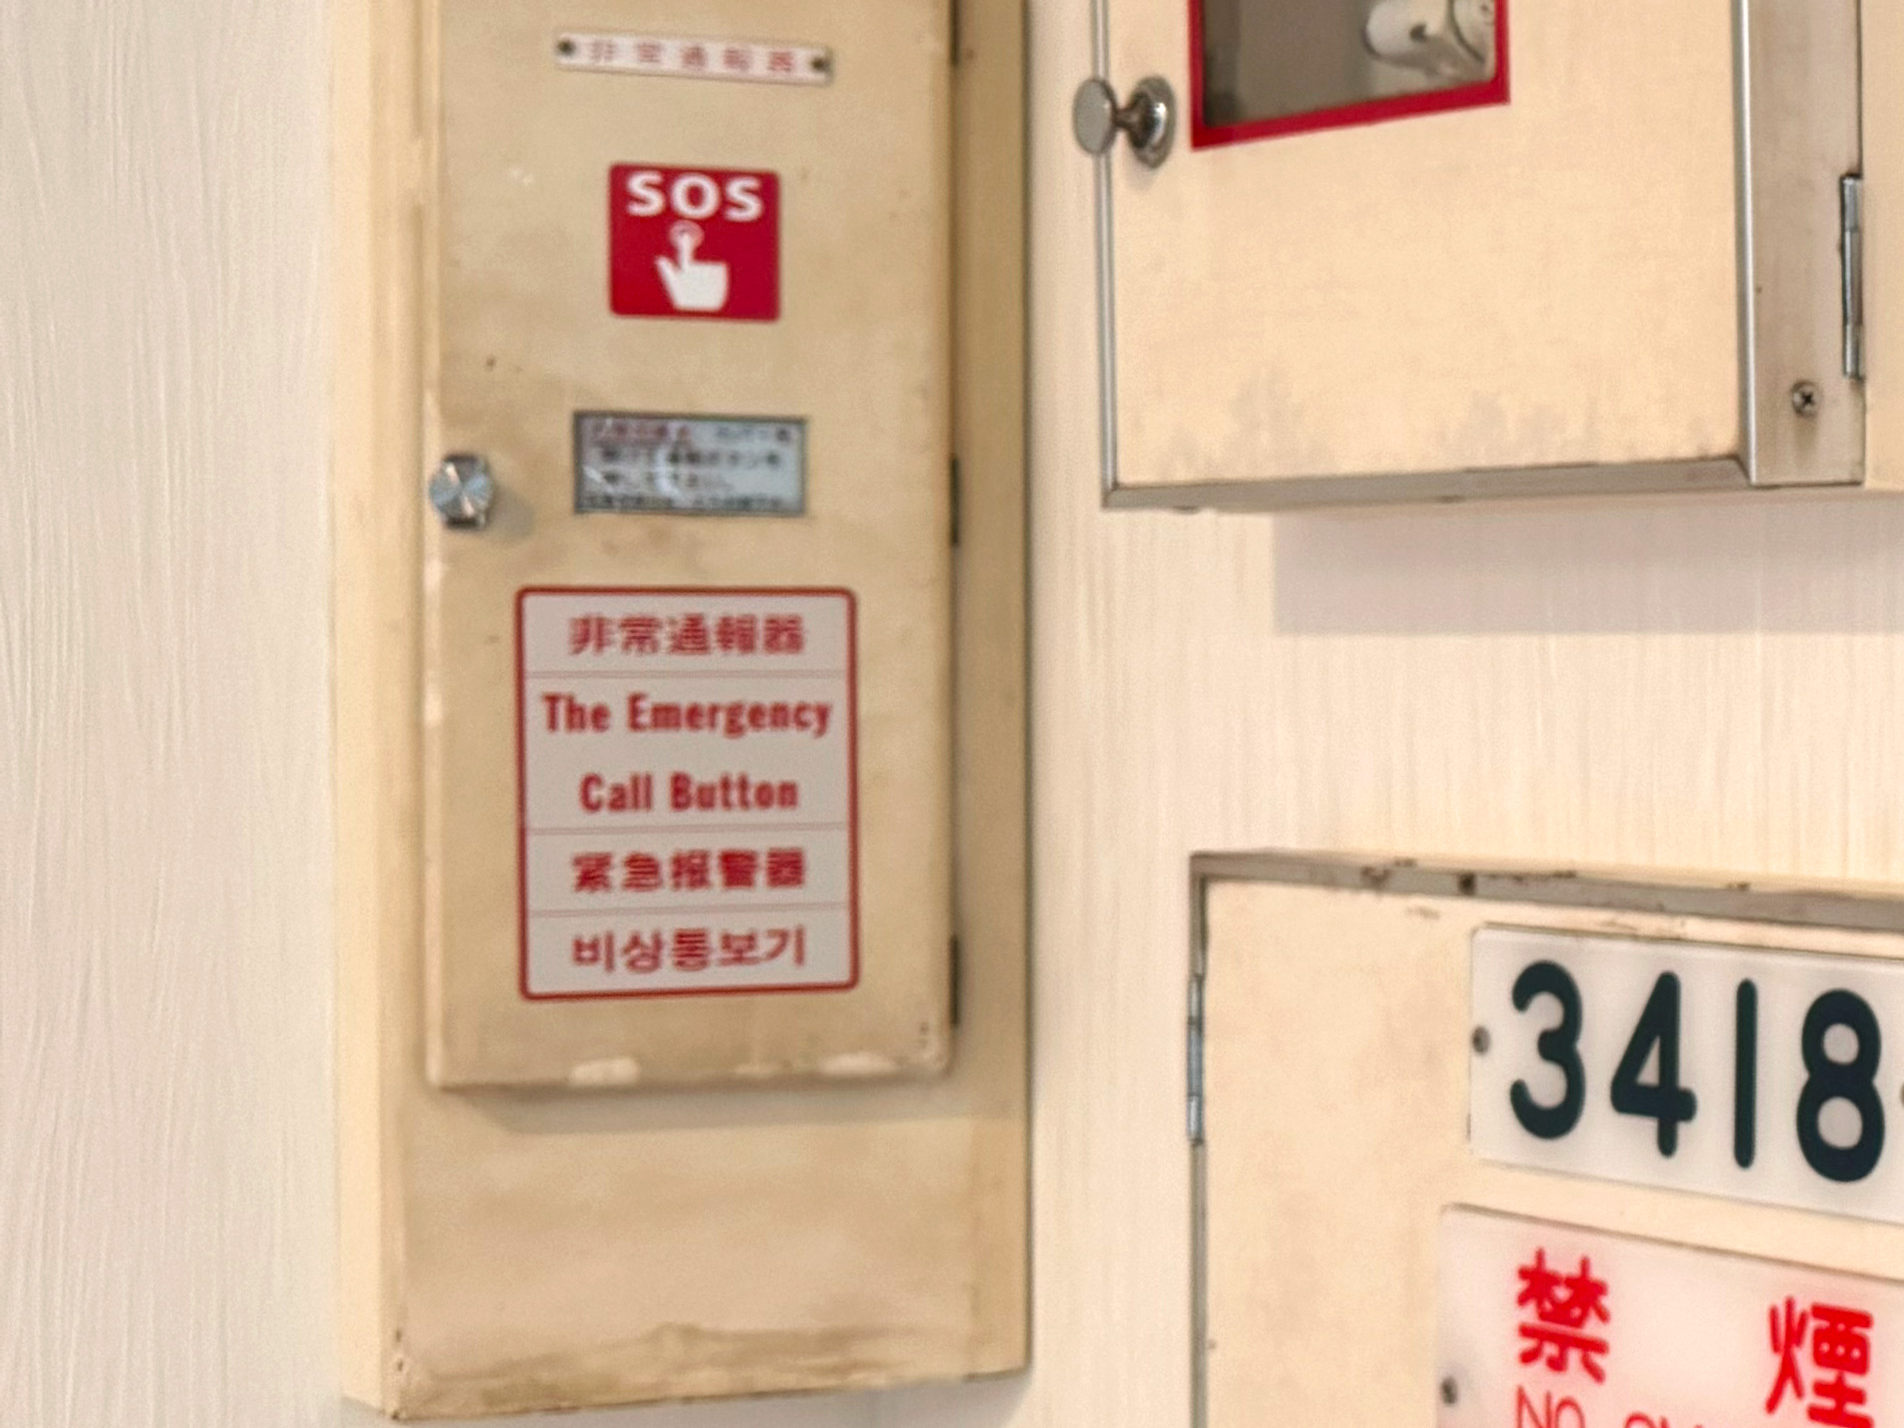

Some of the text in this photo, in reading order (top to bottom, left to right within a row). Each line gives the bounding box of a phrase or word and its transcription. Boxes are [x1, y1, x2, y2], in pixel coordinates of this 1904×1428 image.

[626, 170, 765, 222] SOS
[569, 613, 805, 656] 非常通報器
[541, 692, 832, 740] The Emergency
[579, 772, 799, 812] Call Button
[571, 924, 806, 974] 비상통보기
[1509, 959, 1887, 1184] 3418
